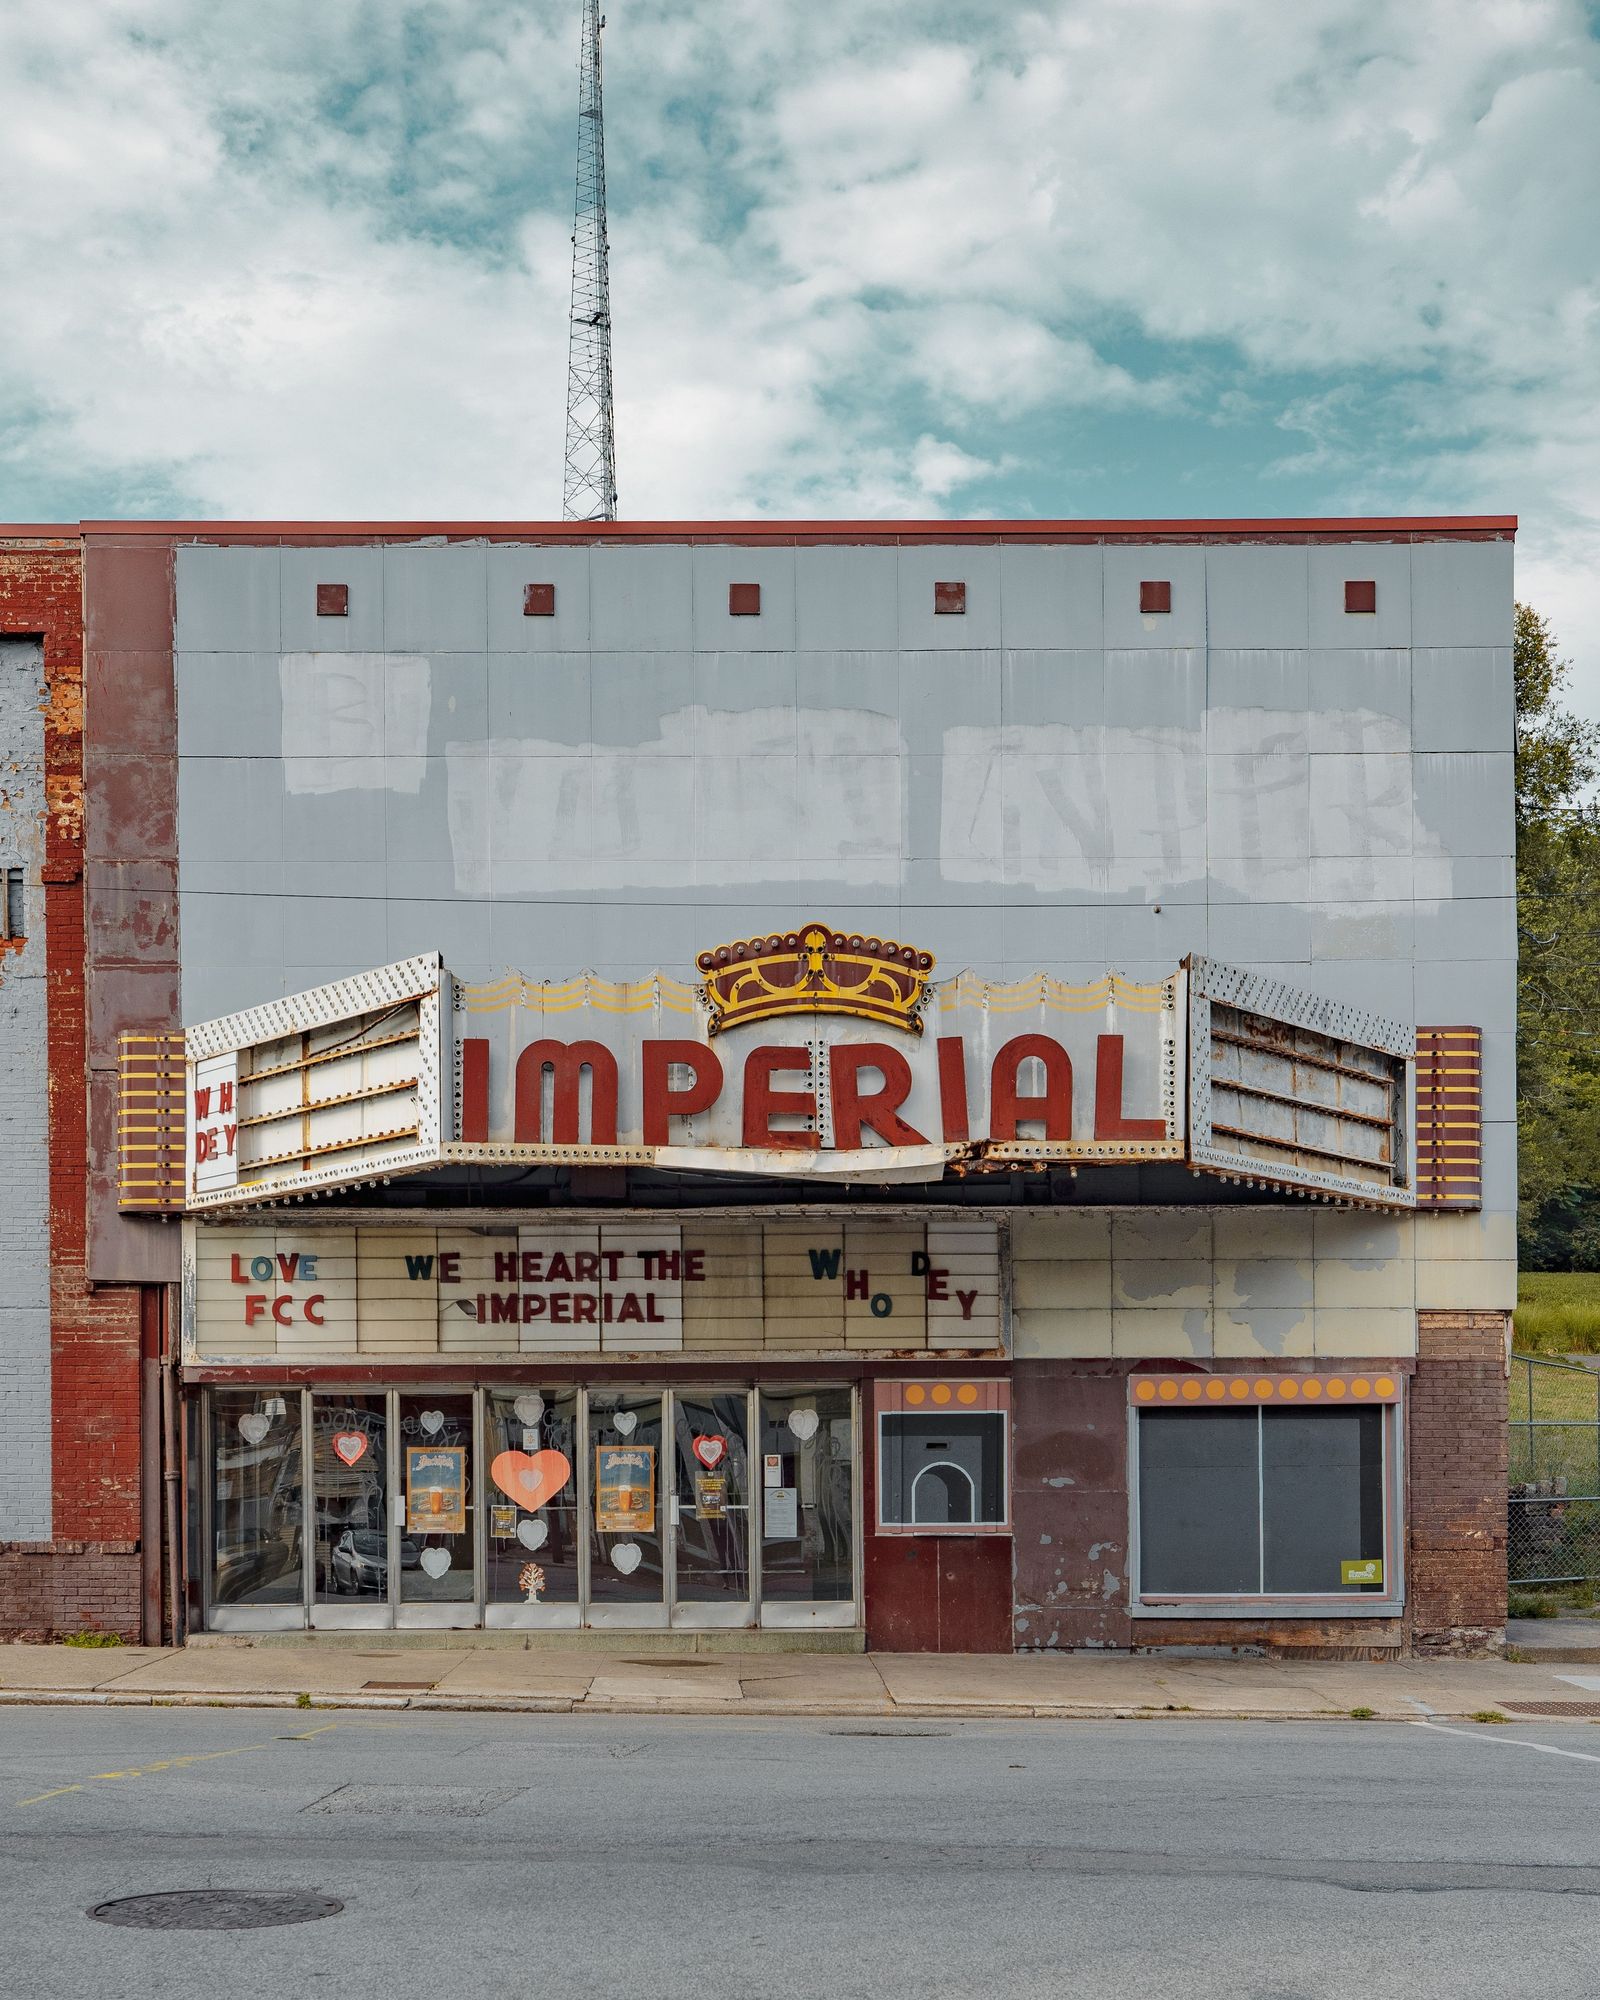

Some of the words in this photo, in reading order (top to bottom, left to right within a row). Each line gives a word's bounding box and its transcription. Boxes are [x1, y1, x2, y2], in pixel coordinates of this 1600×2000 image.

[463, 1034, 1166, 1150] IMPERIAL
[196, 1124, 237, 1163] DEY
[231, 1253, 318, 1284] LOVE
[404, 1252, 461, 1283] WE
[494, 1251, 625, 1283] HEART
[637, 1250, 706, 1282] THE
[808, 1248, 893, 1318] WHO
[911, 1251, 978, 1320] DEY
[245, 1294, 325, 1326] FCC
[476, 1292, 665, 1324] IMPERIAL
